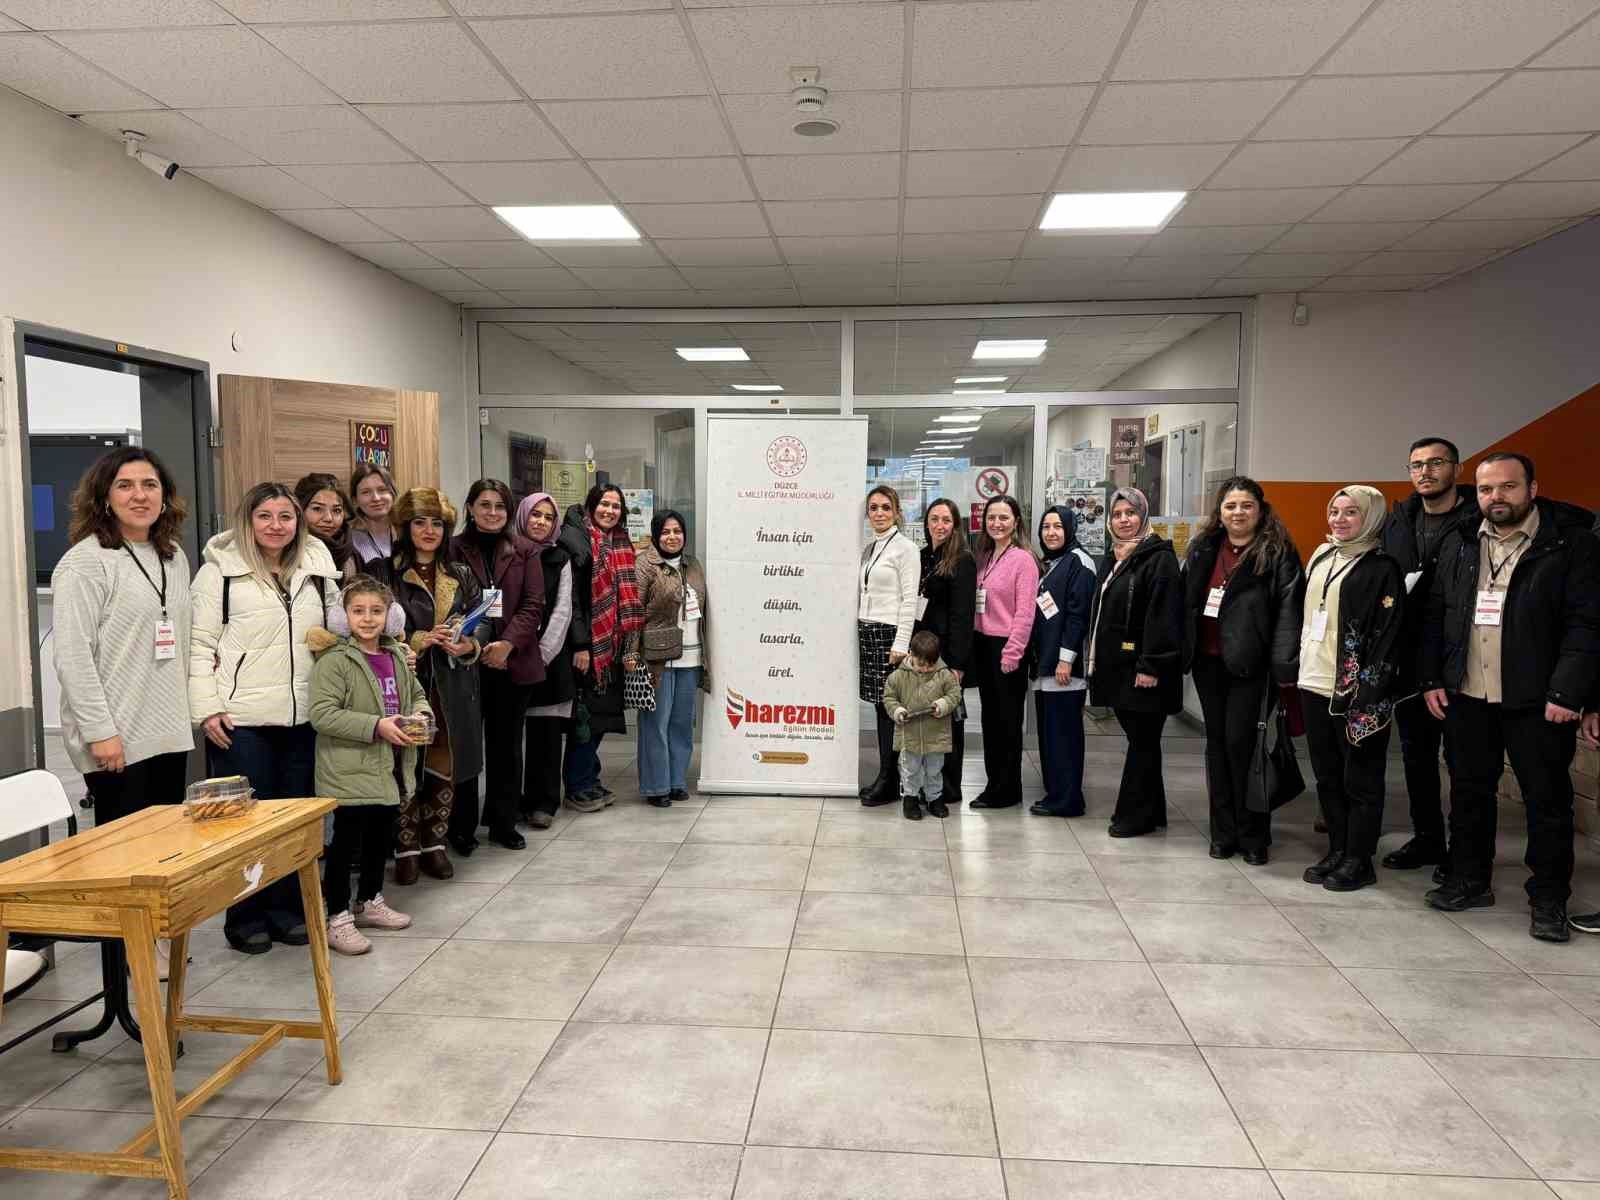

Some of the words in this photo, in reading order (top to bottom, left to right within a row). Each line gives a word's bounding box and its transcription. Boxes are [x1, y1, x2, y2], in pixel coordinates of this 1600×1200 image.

[756, 527, 789, 543] İnsan
[792, 531, 814, 546] için
[763, 565, 805, 577] birlikte
